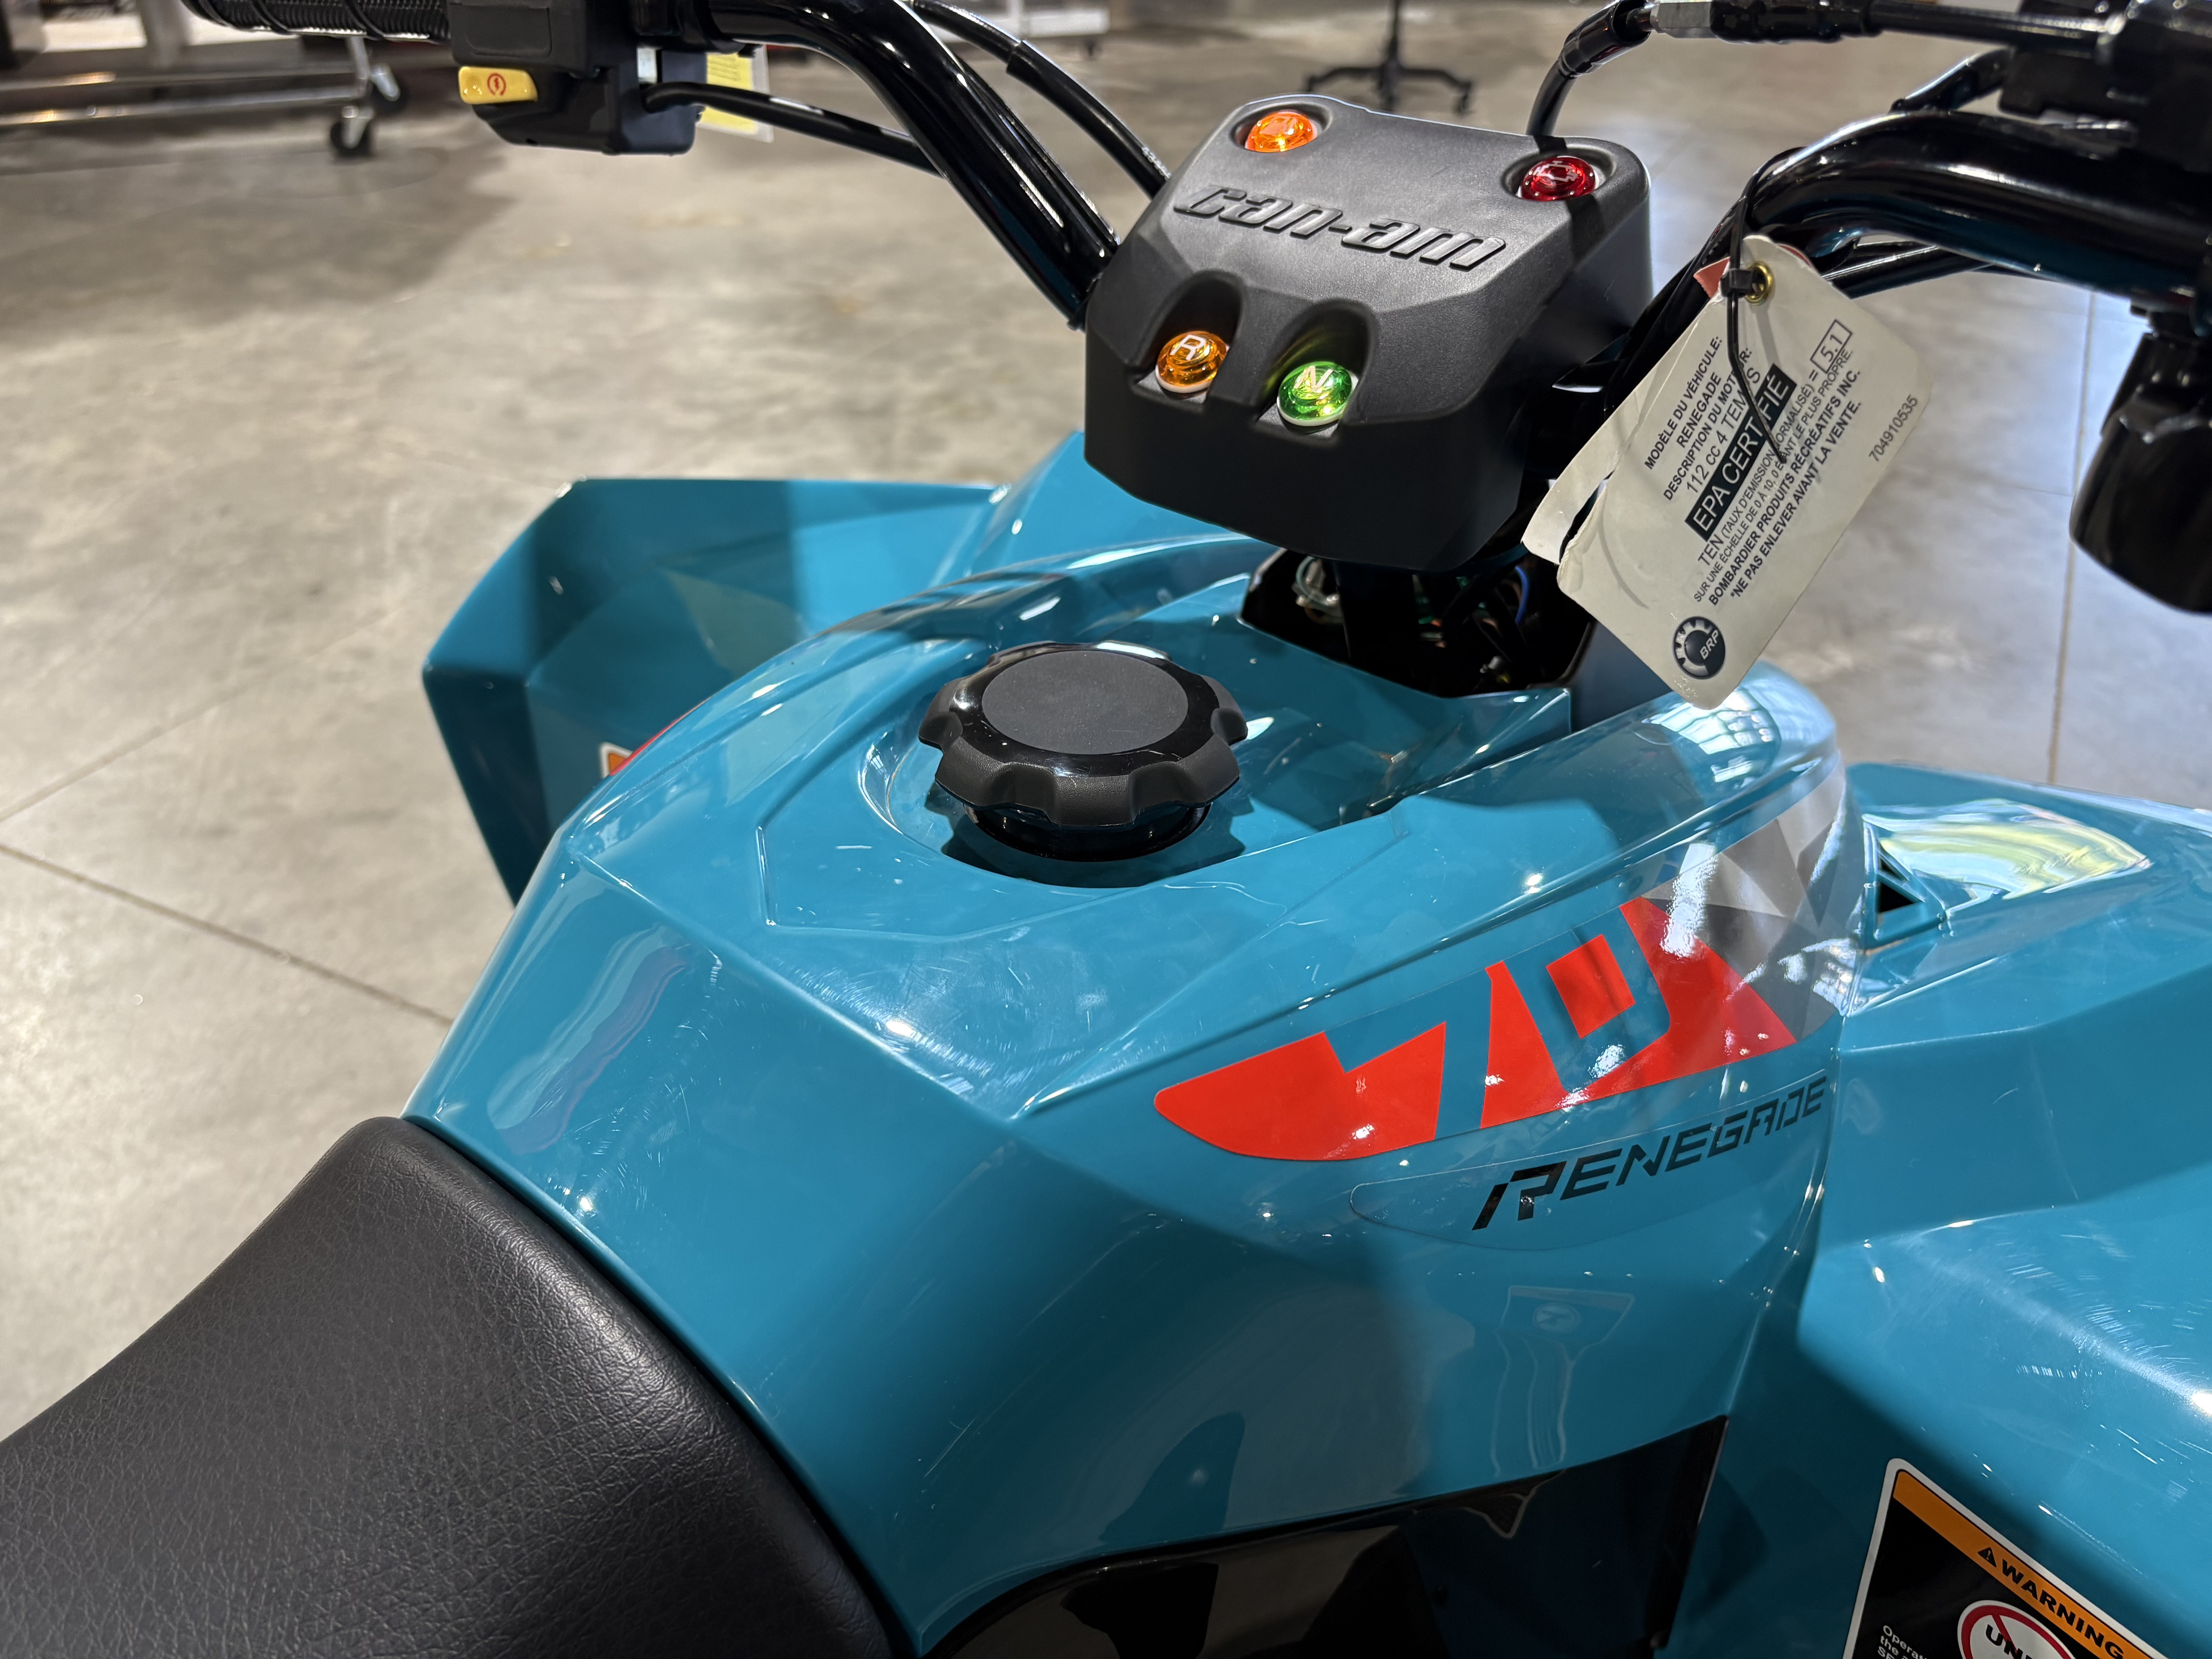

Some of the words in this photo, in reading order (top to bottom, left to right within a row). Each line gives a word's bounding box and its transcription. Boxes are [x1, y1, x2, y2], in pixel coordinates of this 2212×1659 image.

[1173, 185, 1506, 270] can-am
[1169, 334, 1207, 360] R
[1295, 366, 1333, 392] N
[1818, 349, 1853, 398] PROPRE.
[1644, 419, 1674, 469] MODÈLE
[1673, 400, 1687, 419] DU
[1684, 337, 1722, 398] VÉHICULE:
[1676, 372, 1721, 448] RENEGADE
[1721, 368, 1760, 429] TEMS
[1802, 398, 1821, 424] PLUS
[1663, 423, 1712, 500] DESCRIPTION
[1708, 405, 1721, 424] DU
[1720, 347, 1752, 405] MOTR:
[1717, 430, 1728, 444] 4
[1793, 424, 1805, 439] LE
[1869, 393, 1918, 462] 704910535
[1693, 486, 1731, 532] EPA
[1722, 374, 1789, 484] CERTFIÉ
[1698, 534, 1724, 566] TEN
[1721, 506, 1743, 539] (TAUX
[1741, 449, 1776, 508] D'EMISSION
[1776, 383, 1815, 446] ORMALISÉ)
[1820, 334, 1843, 362] 5.1
[1705, 446, 1720, 465] CC
[1775, 440, 1796, 471] ÉANT
[1686, 464, 1709, 493] 112
[1709, 530, 1761, 606] BOMBARDIER
[1756, 473, 1794, 532] PRODUITS
[1790, 395, 1841, 475] RÉCRÉATIFS
[1837, 370, 1860, 397] INC.
[1744, 555, 1763, 580] PAS
[1759, 503, 1796, 556] ENLEVER
[1793, 463, 1819, 505] AVANT
[1815, 445, 1831, 465] LA
[1826, 400, 1862, 446] VENTE.
[1764, 479, 1776, 491] 10,
[1761, 491, 1768, 502] À
[1745, 506, 1758, 523] DE
[1720, 521, 1749, 564] ÉCHELLE
[1707, 562, 1723, 586] UNE
[1694, 582, 1711, 602] SUR
[1700, 630, 1718, 659] BRP
[1471, 1076, 1826, 1231] RENEGADE
[2002, 1558, 2123, 1659] WARNING
[1881, 1636, 1898, 1656] the
